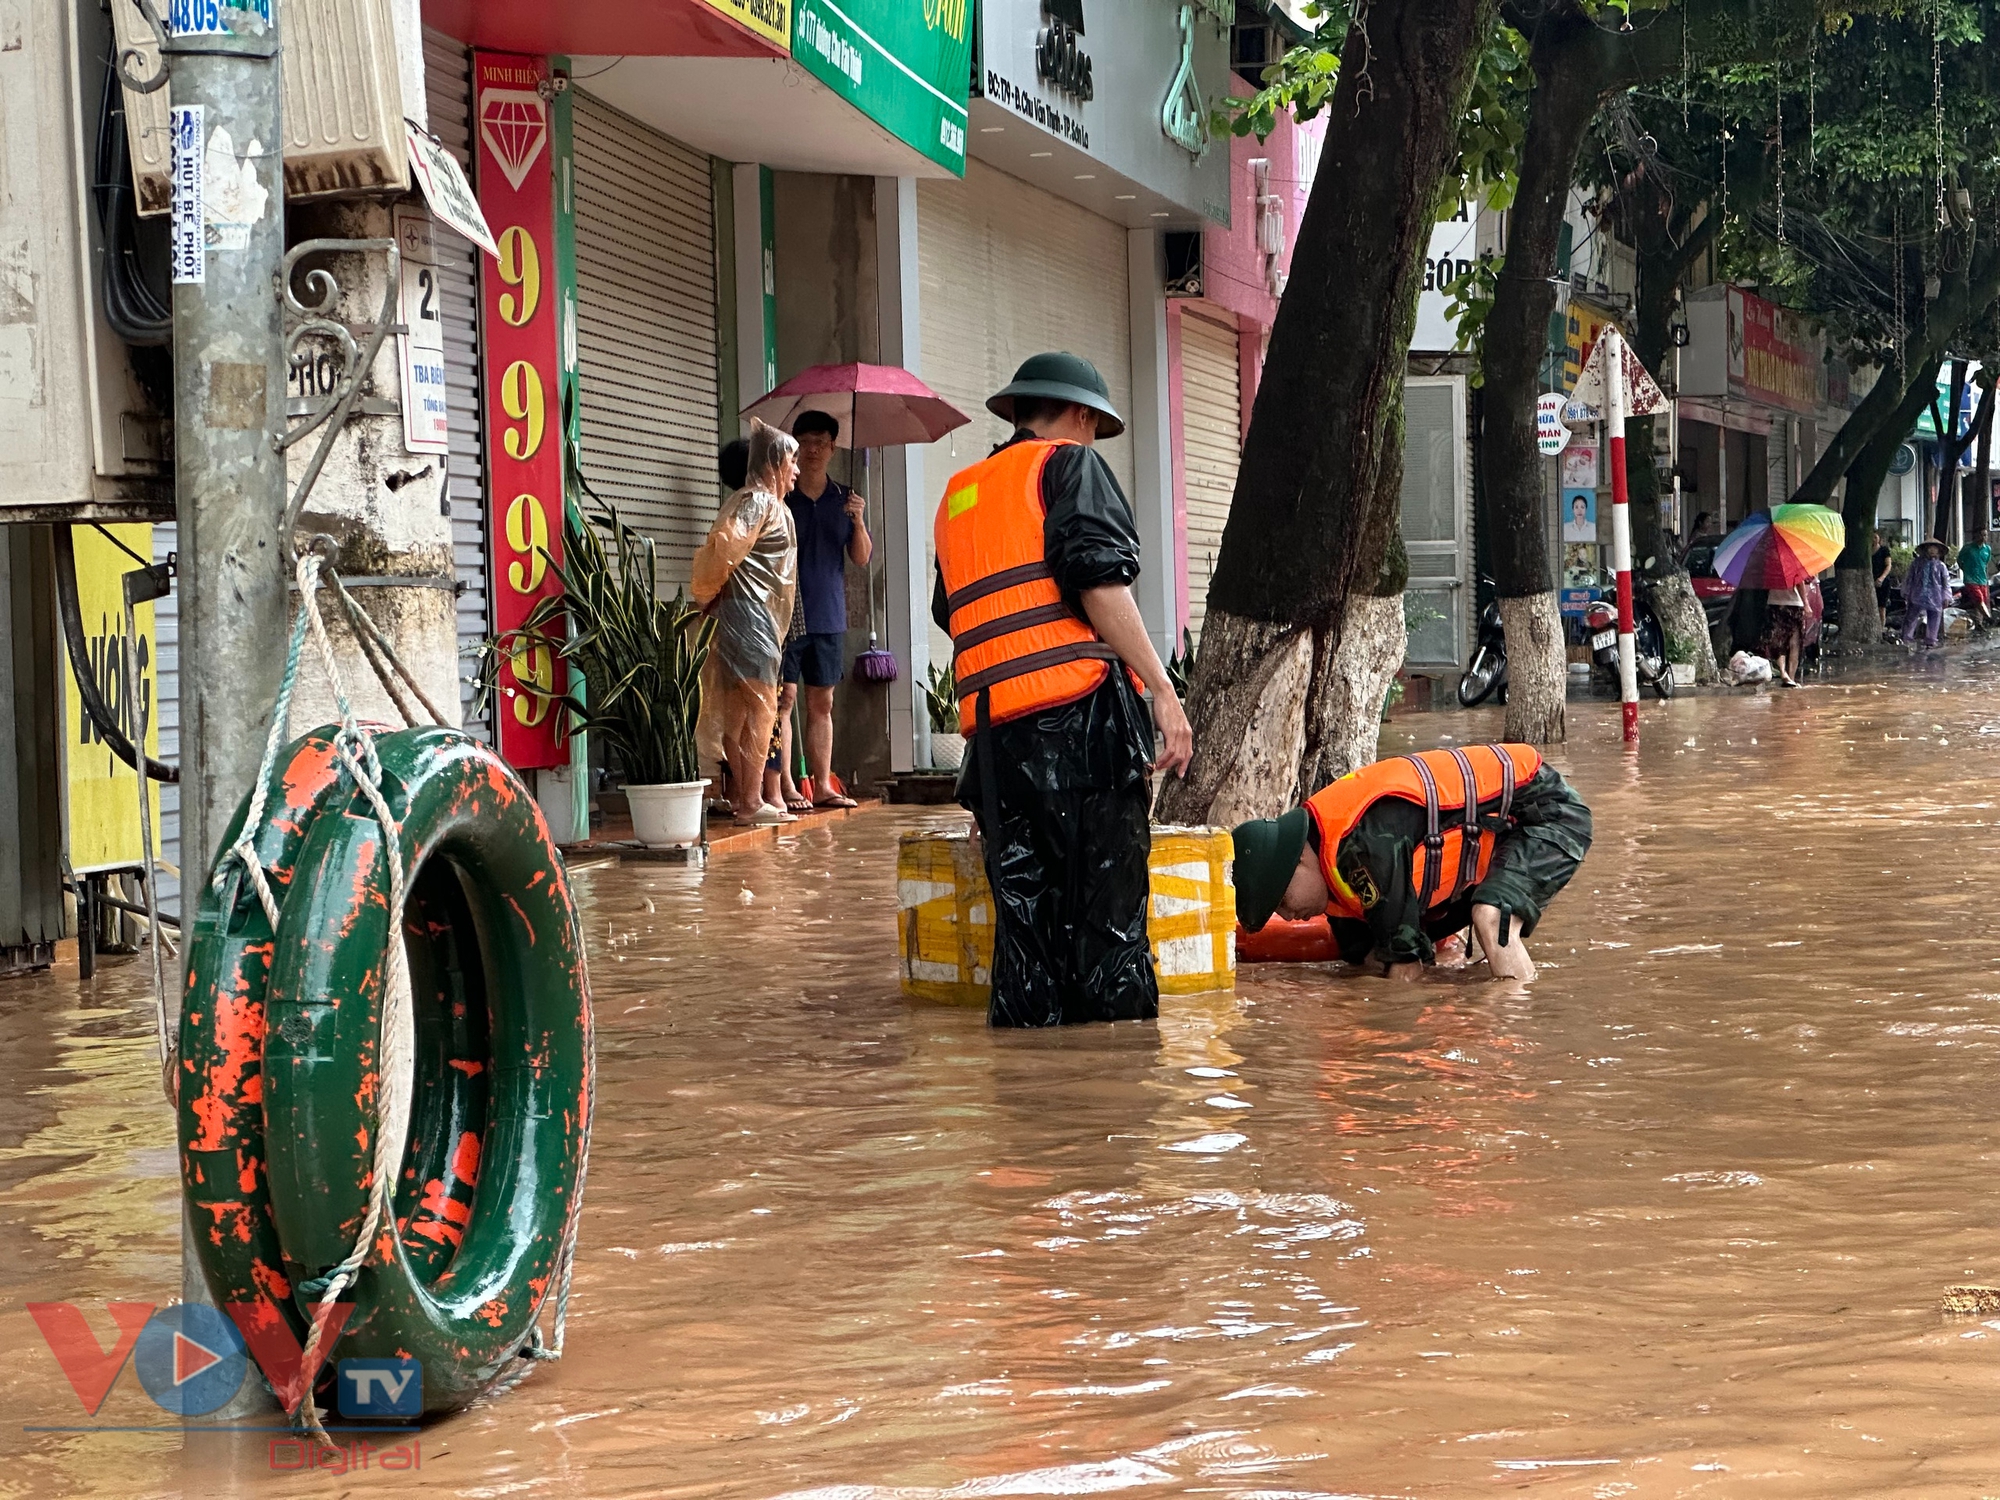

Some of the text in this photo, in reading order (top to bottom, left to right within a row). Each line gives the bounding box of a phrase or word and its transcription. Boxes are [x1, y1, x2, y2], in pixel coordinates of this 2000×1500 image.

[483, 66, 512, 83] MINH
[1000, 77, 1011, 105] 179
[183, 157, 195, 193] HÚT
[184, 232, 198, 279] PHỐT
[413, 364, 429, 384] TBA
